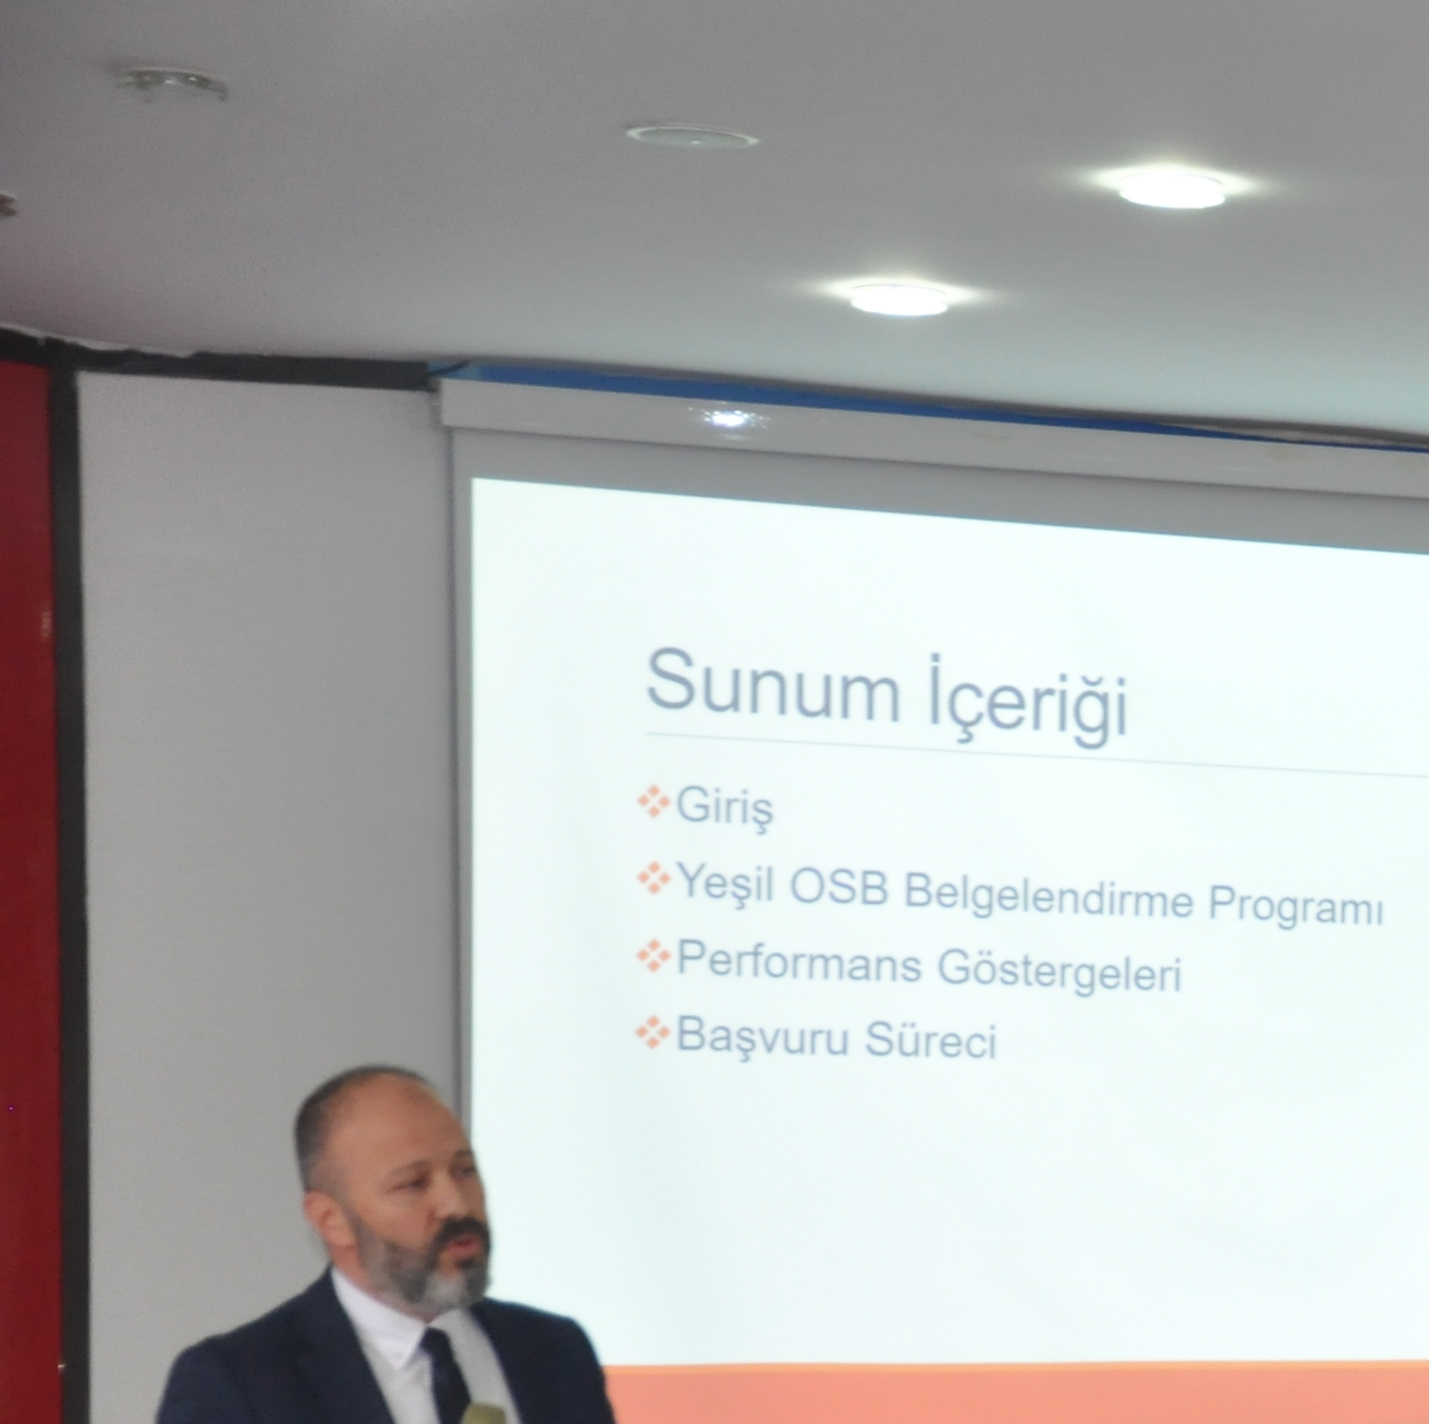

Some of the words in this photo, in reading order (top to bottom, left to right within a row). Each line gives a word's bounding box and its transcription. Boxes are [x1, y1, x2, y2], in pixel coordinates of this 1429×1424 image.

[643, 645, 903, 722] Sunum
[928, 651, 1130, 752] İçeriği
[674, 784, 777, 838] Giriş
[673, 860, 776, 912] Yeşil
[788, 866, 892, 908] OSB
[904, 870, 1197, 922] Belgelendirme
[1207, 882, 1388, 932] Programı
[674, 938, 925, 986] Performans
[935, 946, 1185, 1001] Göstergeleri
[674, 1014, 851, 1065] Başvuru
[863, 1019, 1000, 1062] Süreci
